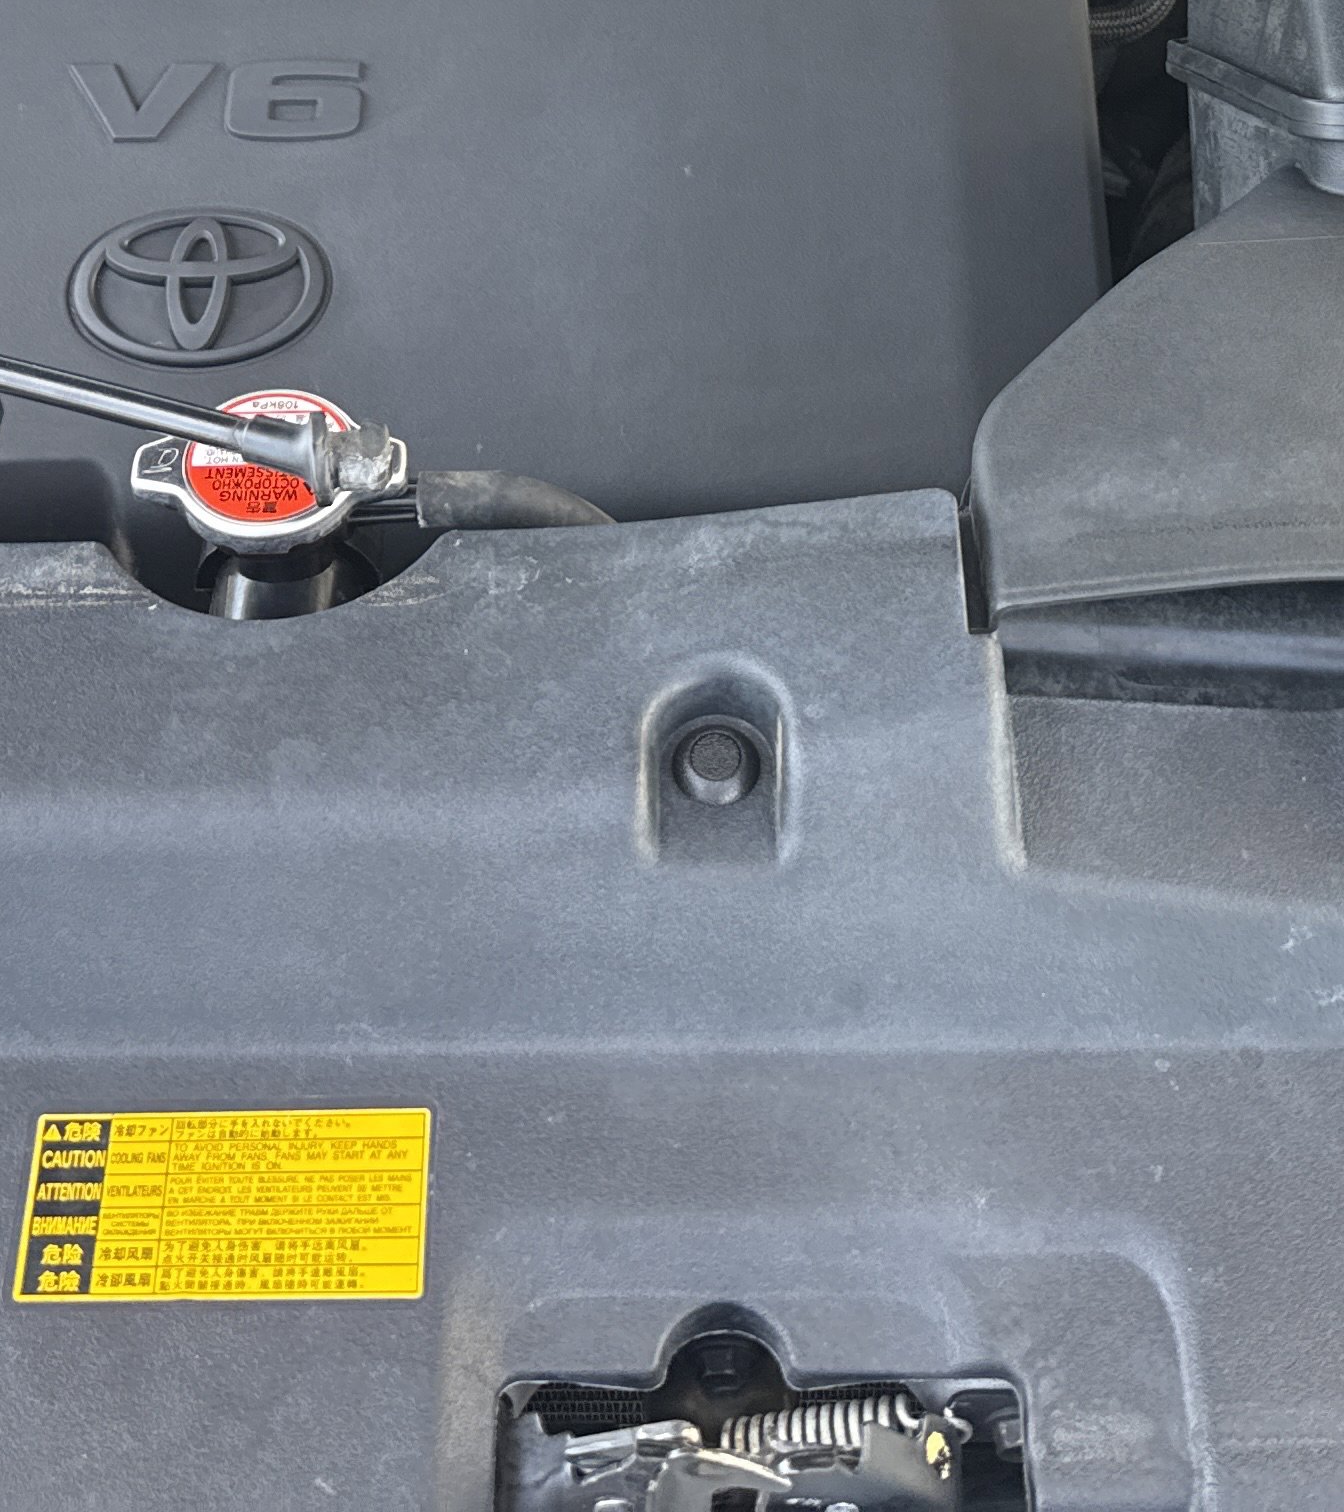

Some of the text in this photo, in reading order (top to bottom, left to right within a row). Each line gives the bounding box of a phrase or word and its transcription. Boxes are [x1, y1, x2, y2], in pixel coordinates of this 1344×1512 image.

[67, 59, 368, 144] V6
[212, 477, 300, 491] ОСТОРОЖНО
[218, 489, 298, 502] WARNING
[62, 1121, 102, 1142] 危険
[114, 1122, 170, 1138] 冷却ファン
[175, 1143, 188, 1152] TO
[193, 1142, 224, 1152] AVOID
[229, 1141, 282, 1151] PERSONAL
[330, 1140, 358, 1149] KEEP
[362, 1139, 398, 1149] HANDS
[41, 1149, 107, 1169] CAUTION
[111, 1151, 167, 1164] COOLING FANS
[173, 1152, 202, 1162] AWAY
[206, 1152, 236, 1161] FROM
[275, 1151, 302, 1160] FANS
[306, 1150, 329, 1160] MAY
[332, 1149, 365, 1160] START
[369, 1149, 384, 1159] AT
[386, 1148, 409, 1159] ANY
[172, 1162, 196, 1171] TIME
[201, 1161, 246, 1170] IGNITION
[251, 1161, 261, 1170] IS
[169, 1176, 193, 1185] POUR
[228, 1175, 254, 1184] TOUTE
[304, 1175, 316, 1183] NE
[35, 1182, 103, 1202] ATTENTION
[106, 1185, 163, 1198] VENTILATEURS
[256, 1185, 313, 1194] VENTILATEURS
[370, 1184, 404, 1192] METTRE
[254, 1195, 288, 1203] MOMENT
[316, 1194, 353, 1202] CONTACT
[31, 1215, 99, 1236] ВНИМАНИЕ
[40, 1243, 84, 1265] 危险
[98, 1246, 154, 1261] 冷却风扇
[36, 1270, 81, 1292] 危險
